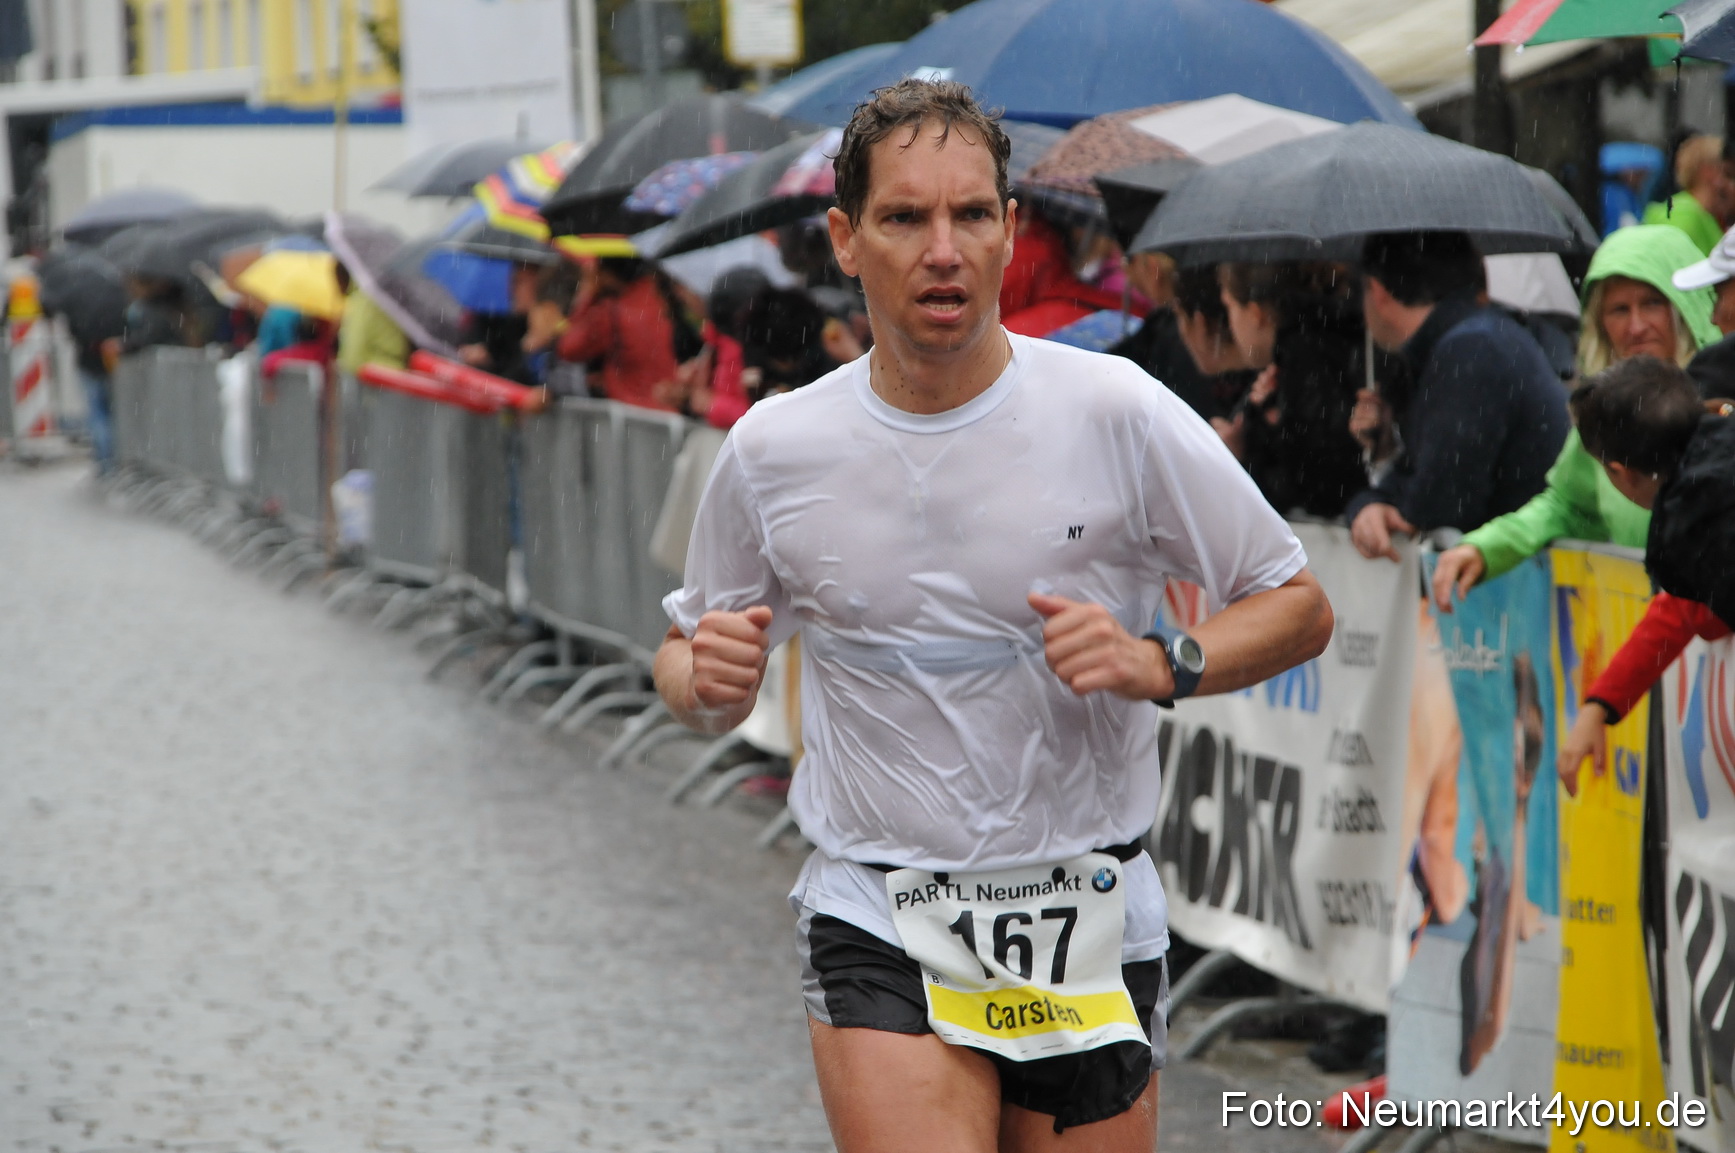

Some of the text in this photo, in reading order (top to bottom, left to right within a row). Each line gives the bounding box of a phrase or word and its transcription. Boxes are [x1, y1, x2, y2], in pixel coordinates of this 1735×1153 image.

[1067, 525, 1084, 540] NY
[895, 875, 1081, 910] PARTL Neumarkt
[948, 907, 1078, 985] 167
[986, 996, 1085, 1031] Carsten
